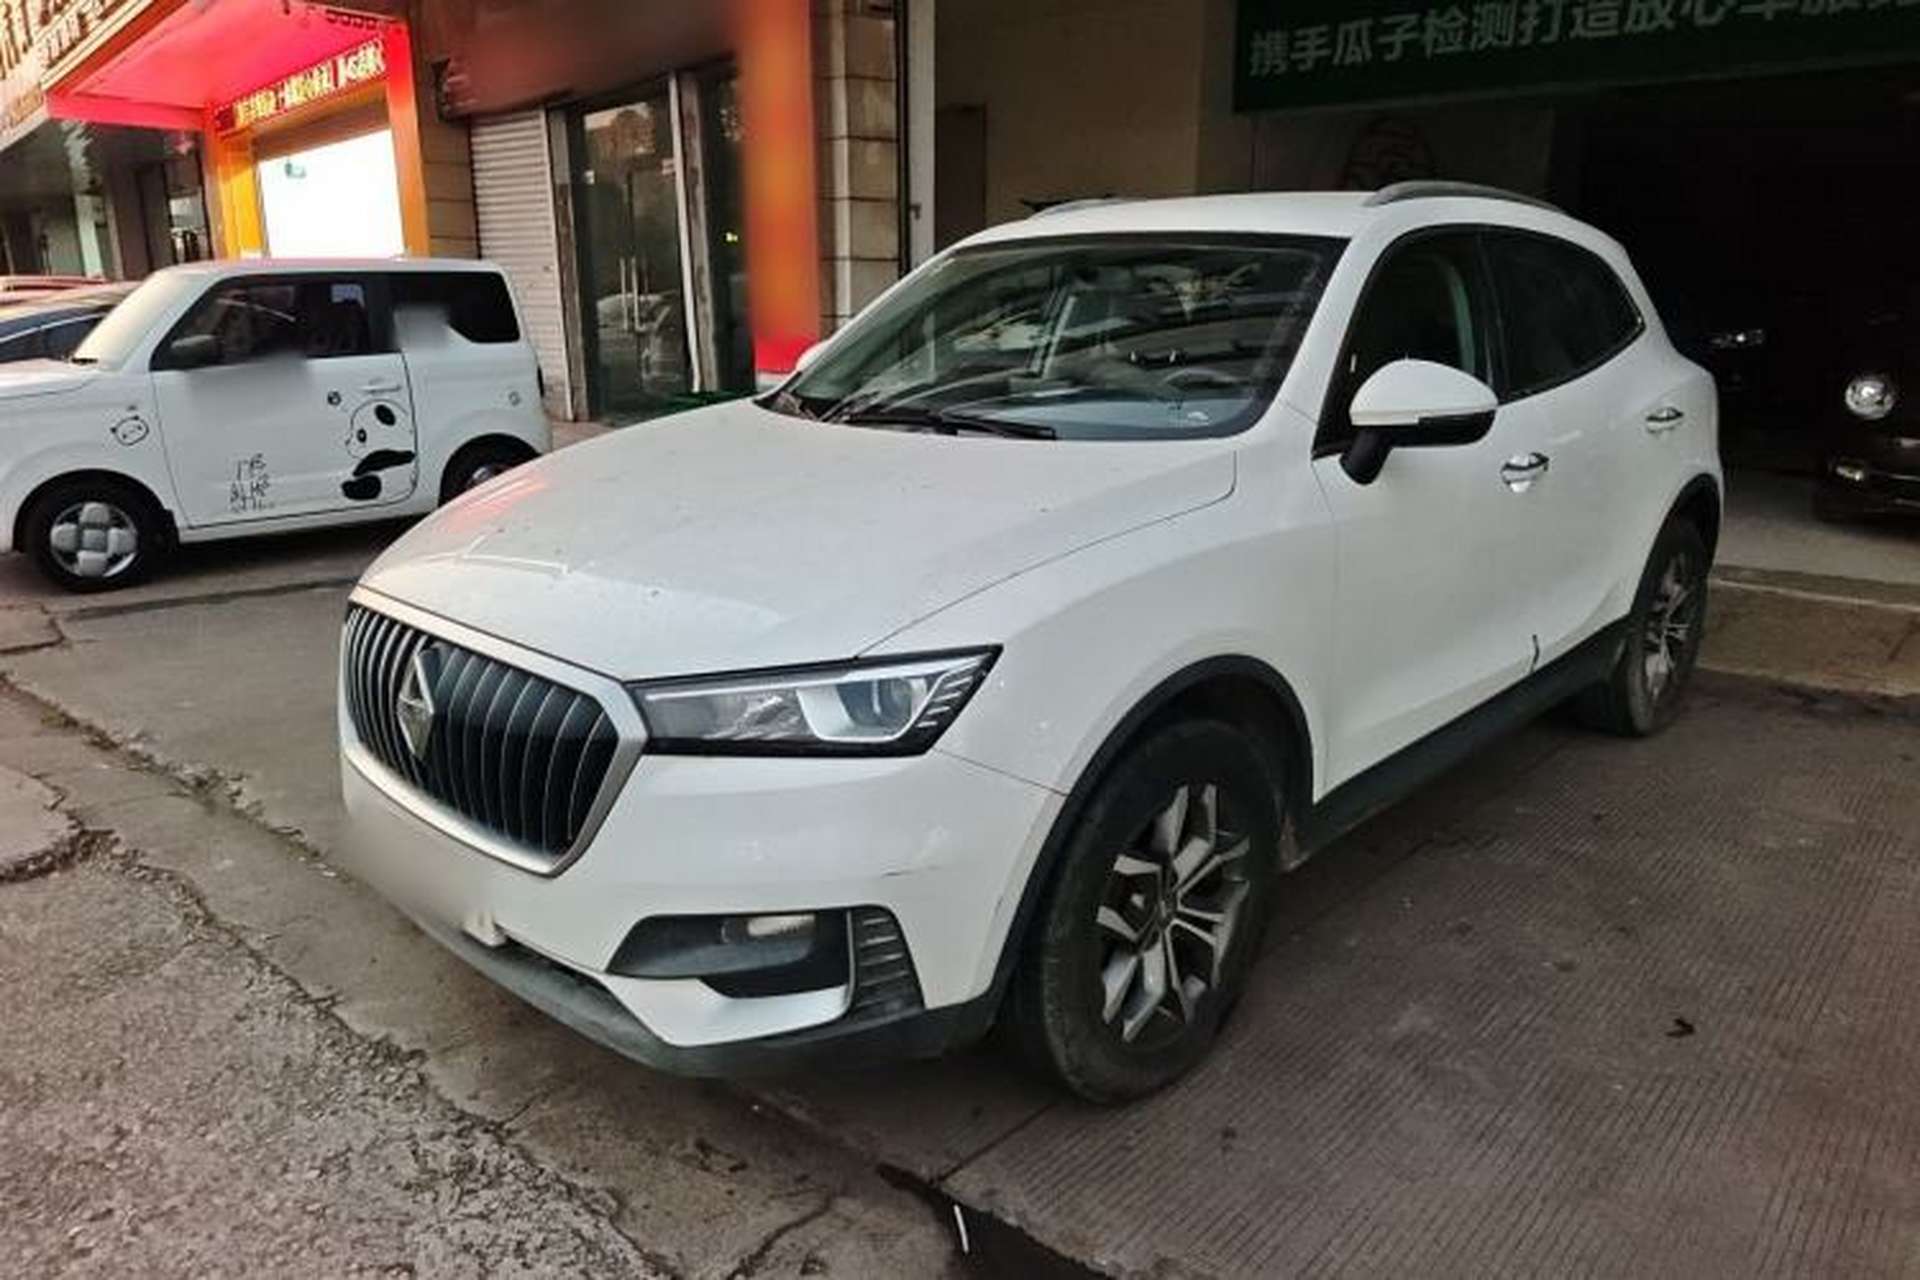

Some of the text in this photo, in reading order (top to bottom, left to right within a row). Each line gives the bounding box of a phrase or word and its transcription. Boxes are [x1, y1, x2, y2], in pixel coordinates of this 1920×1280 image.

[1249, 0, 1920, 78] 携手瓜子检测打造放心
